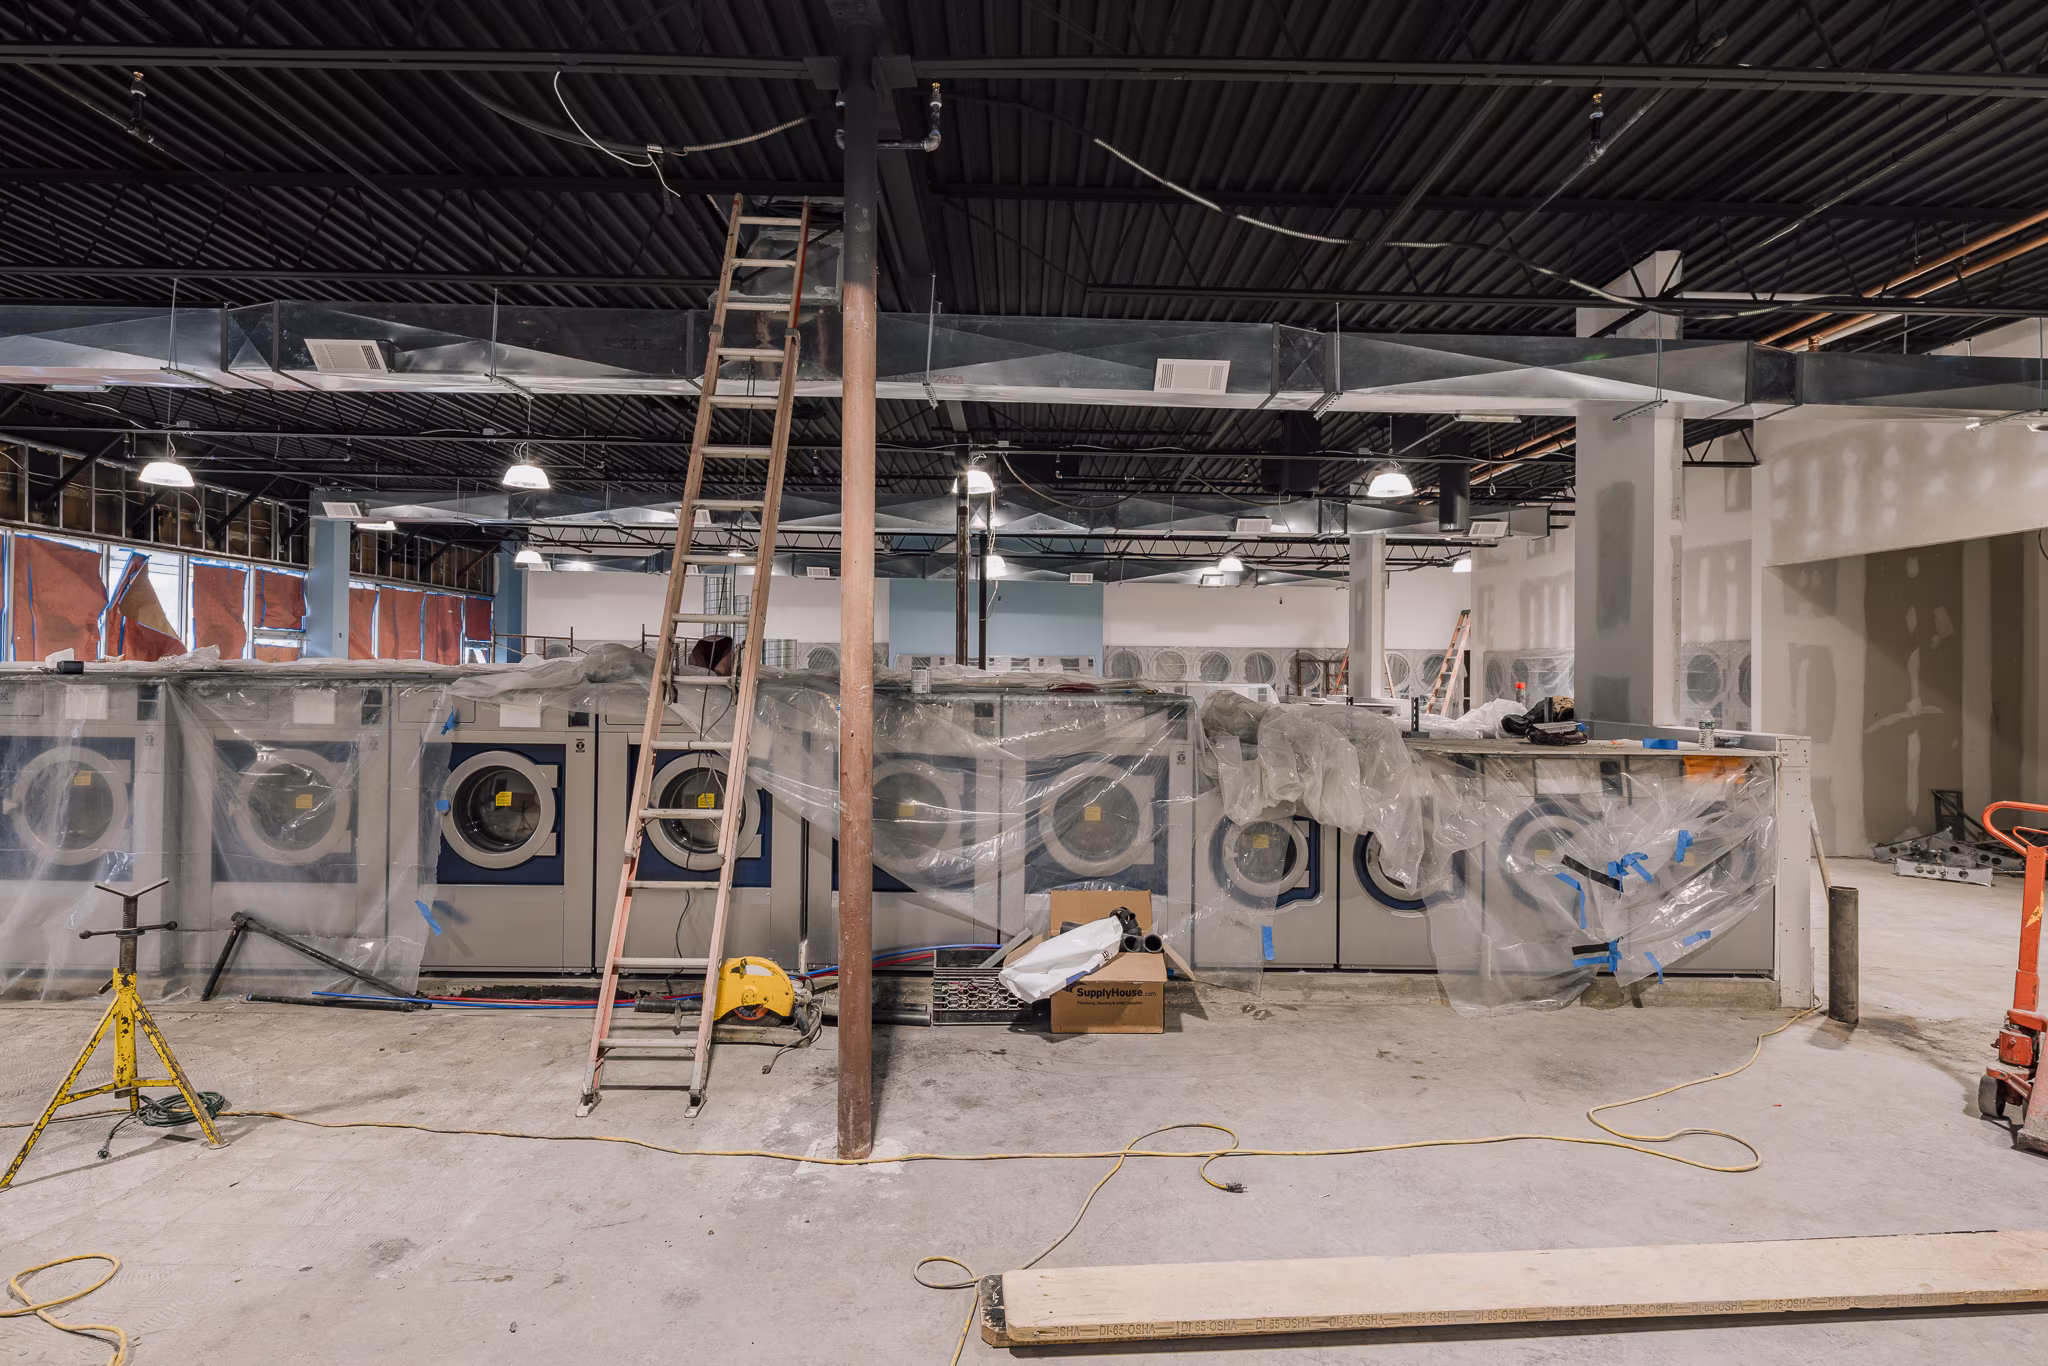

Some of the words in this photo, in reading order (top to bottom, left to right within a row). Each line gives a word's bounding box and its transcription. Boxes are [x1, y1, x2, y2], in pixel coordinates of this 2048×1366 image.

[1076, 987, 1157, 999] SupplyHouse.com
[1099, 1323, 1156, 1336] DI-65-OSHA
[1181, 1320, 1238, 1332] DI-65-OSHA
[1255, 1317, 1312, 1330] DI-65-OSHA
[1329, 1314, 1385, 1327] DI-65-OSHA
